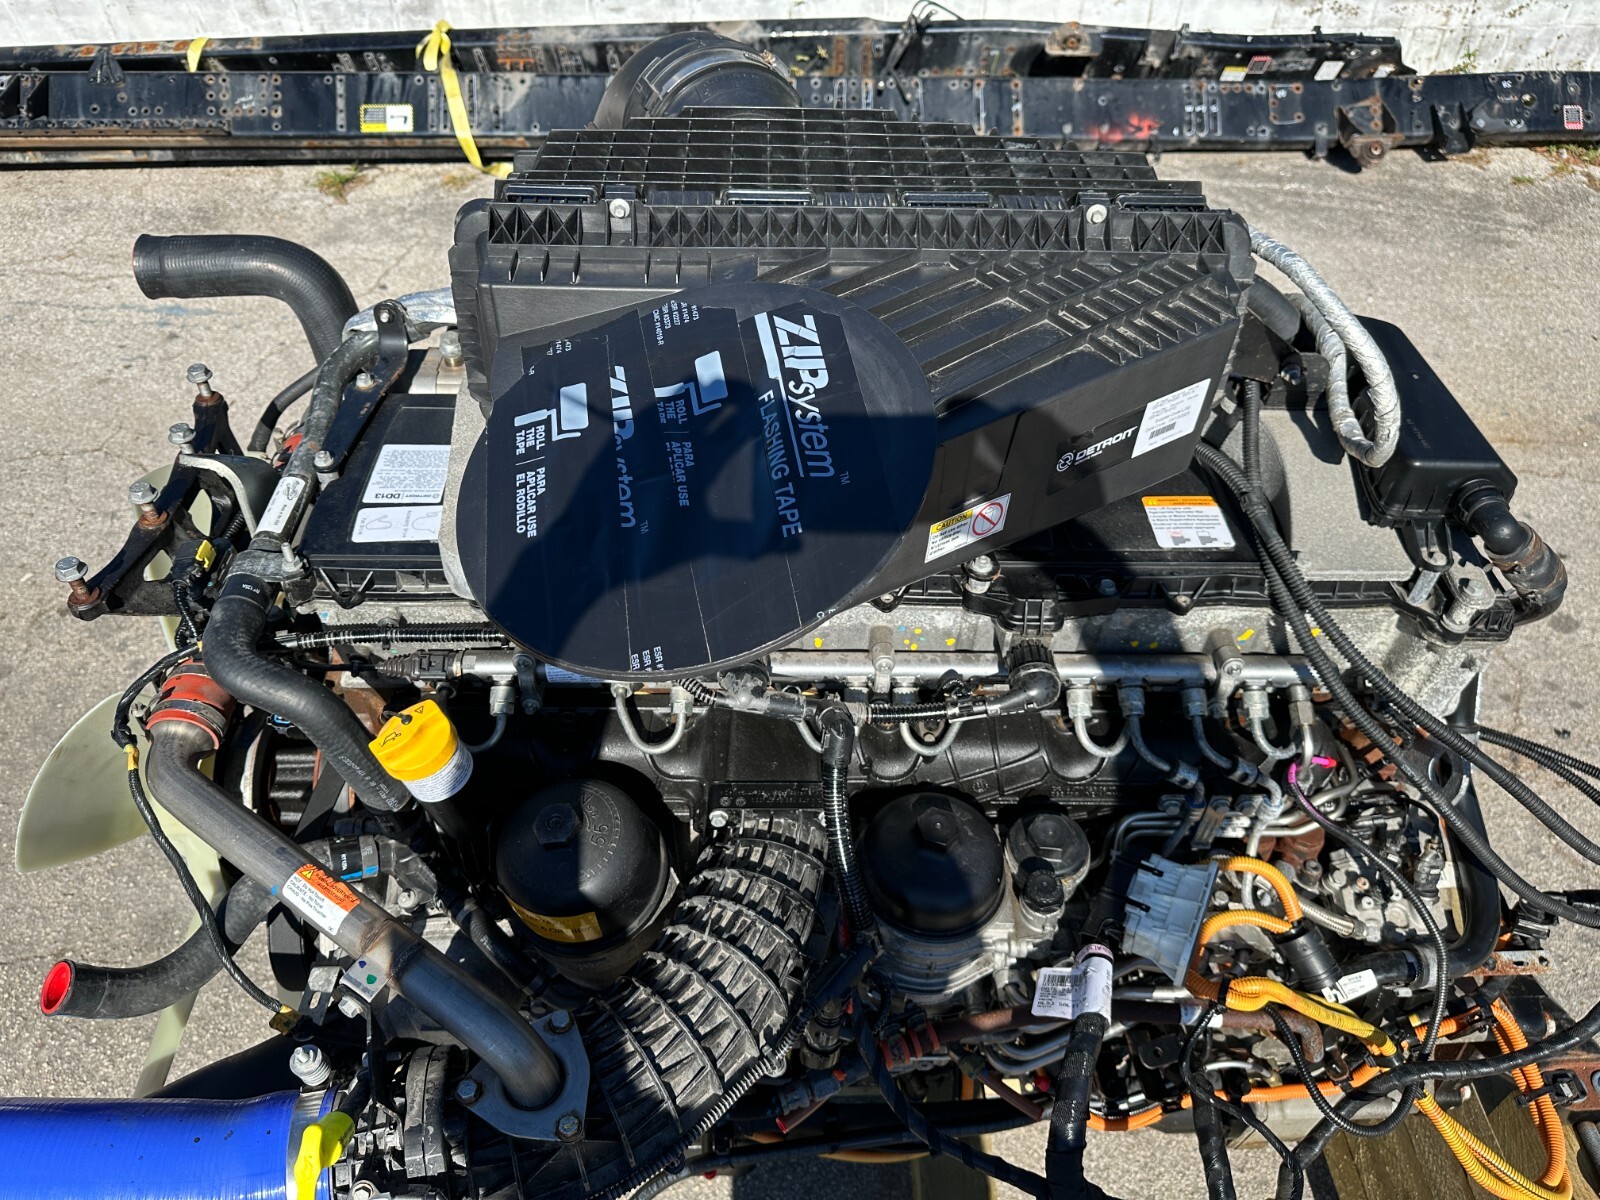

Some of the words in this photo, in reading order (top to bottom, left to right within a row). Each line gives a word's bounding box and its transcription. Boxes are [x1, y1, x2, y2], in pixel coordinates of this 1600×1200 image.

[773, 315, 829, 390] ZIP
[665, 402, 676, 420] THE
[676, 399, 688, 424] ROLL
[516, 430, 525, 455] TAPE
[526, 427, 535, 447] THE
[536, 425, 545, 450] ROLL
[1075, 426, 1138, 460] DETROIT
[671, 441, 686, 483] APLICAR
[682, 442, 695, 467] PARA
[758, 389, 790, 480] FLASHING
[774, 482, 803, 538] TAPE
[516, 473, 525, 487] EL
[537, 467, 545, 495] PARA
[527, 472, 536, 514] APLICAR
[677, 486, 689, 507] USE
[516, 488, 526, 533] RODILLO
[936, 513, 968, 531] CAUTION
[527, 516, 536, 538] USE
[631, 653, 640, 671] ESR
[642, 649, 651, 666] ESR
[654, 646, 663, 663] ESR
